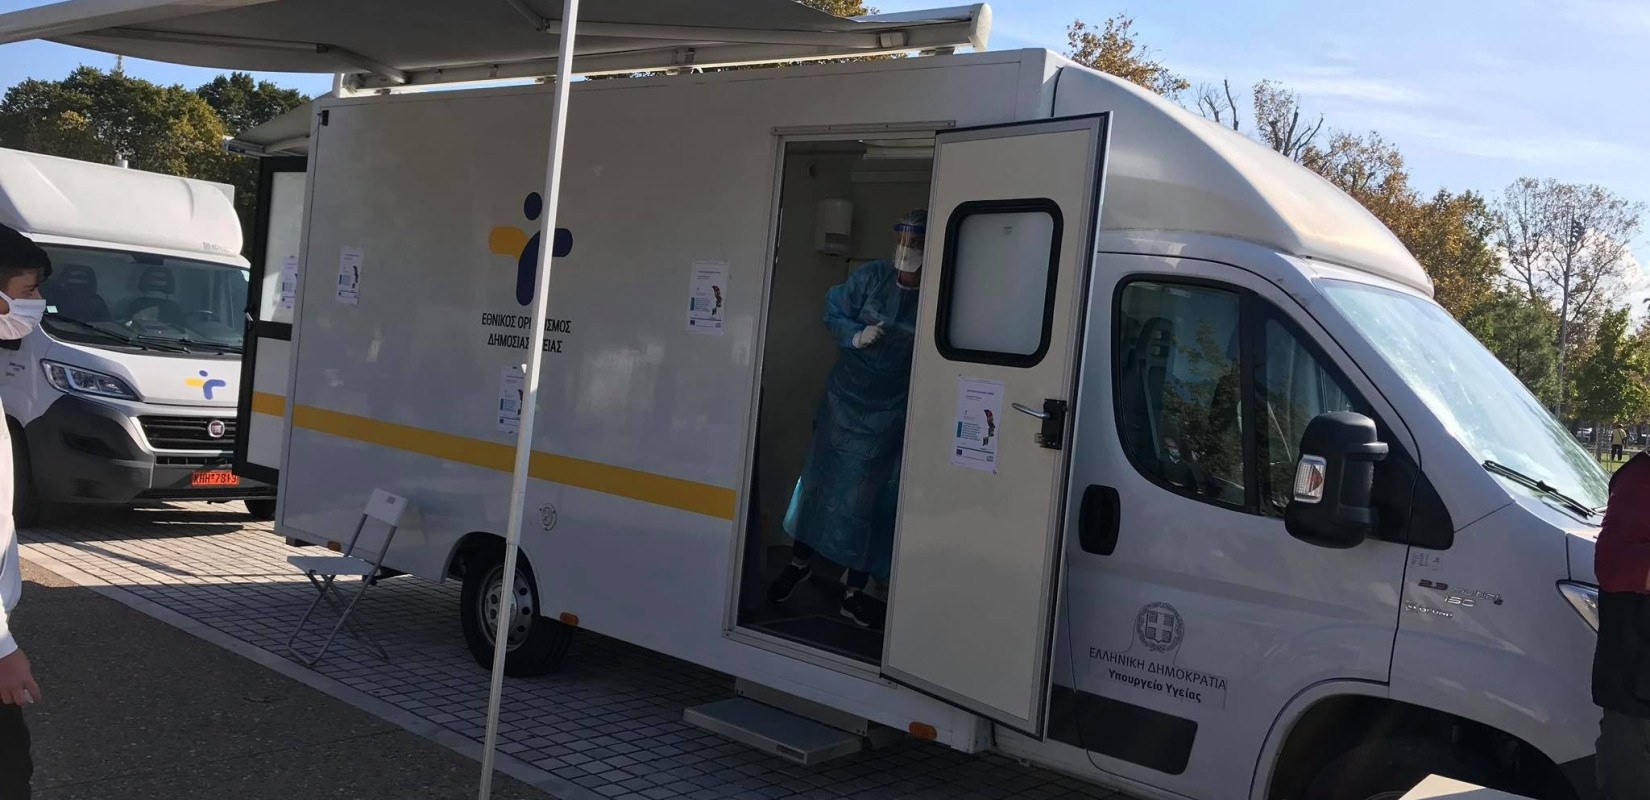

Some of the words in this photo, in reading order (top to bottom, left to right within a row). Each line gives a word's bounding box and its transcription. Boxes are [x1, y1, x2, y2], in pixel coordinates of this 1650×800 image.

[481, 312, 517, 329] ΕΘΝΙΚΟΣ
[517, 316, 572, 333] ΟΡΙΣΜΟΣ
[487, 333, 530, 350] ΔΗΜΟΣΙΑΣ
[541, 338, 563, 354] ΕΙΑΣ
[1089, 646, 1146, 671] ΕΛΛΗΝΙΚΗ
[1147, 662, 1228, 691] ΔΗΜΟΚΡΑΤΙΑ
[1108, 668, 1163, 692] Υπουργείο
[1165, 682, 1202, 704] Υγείας
